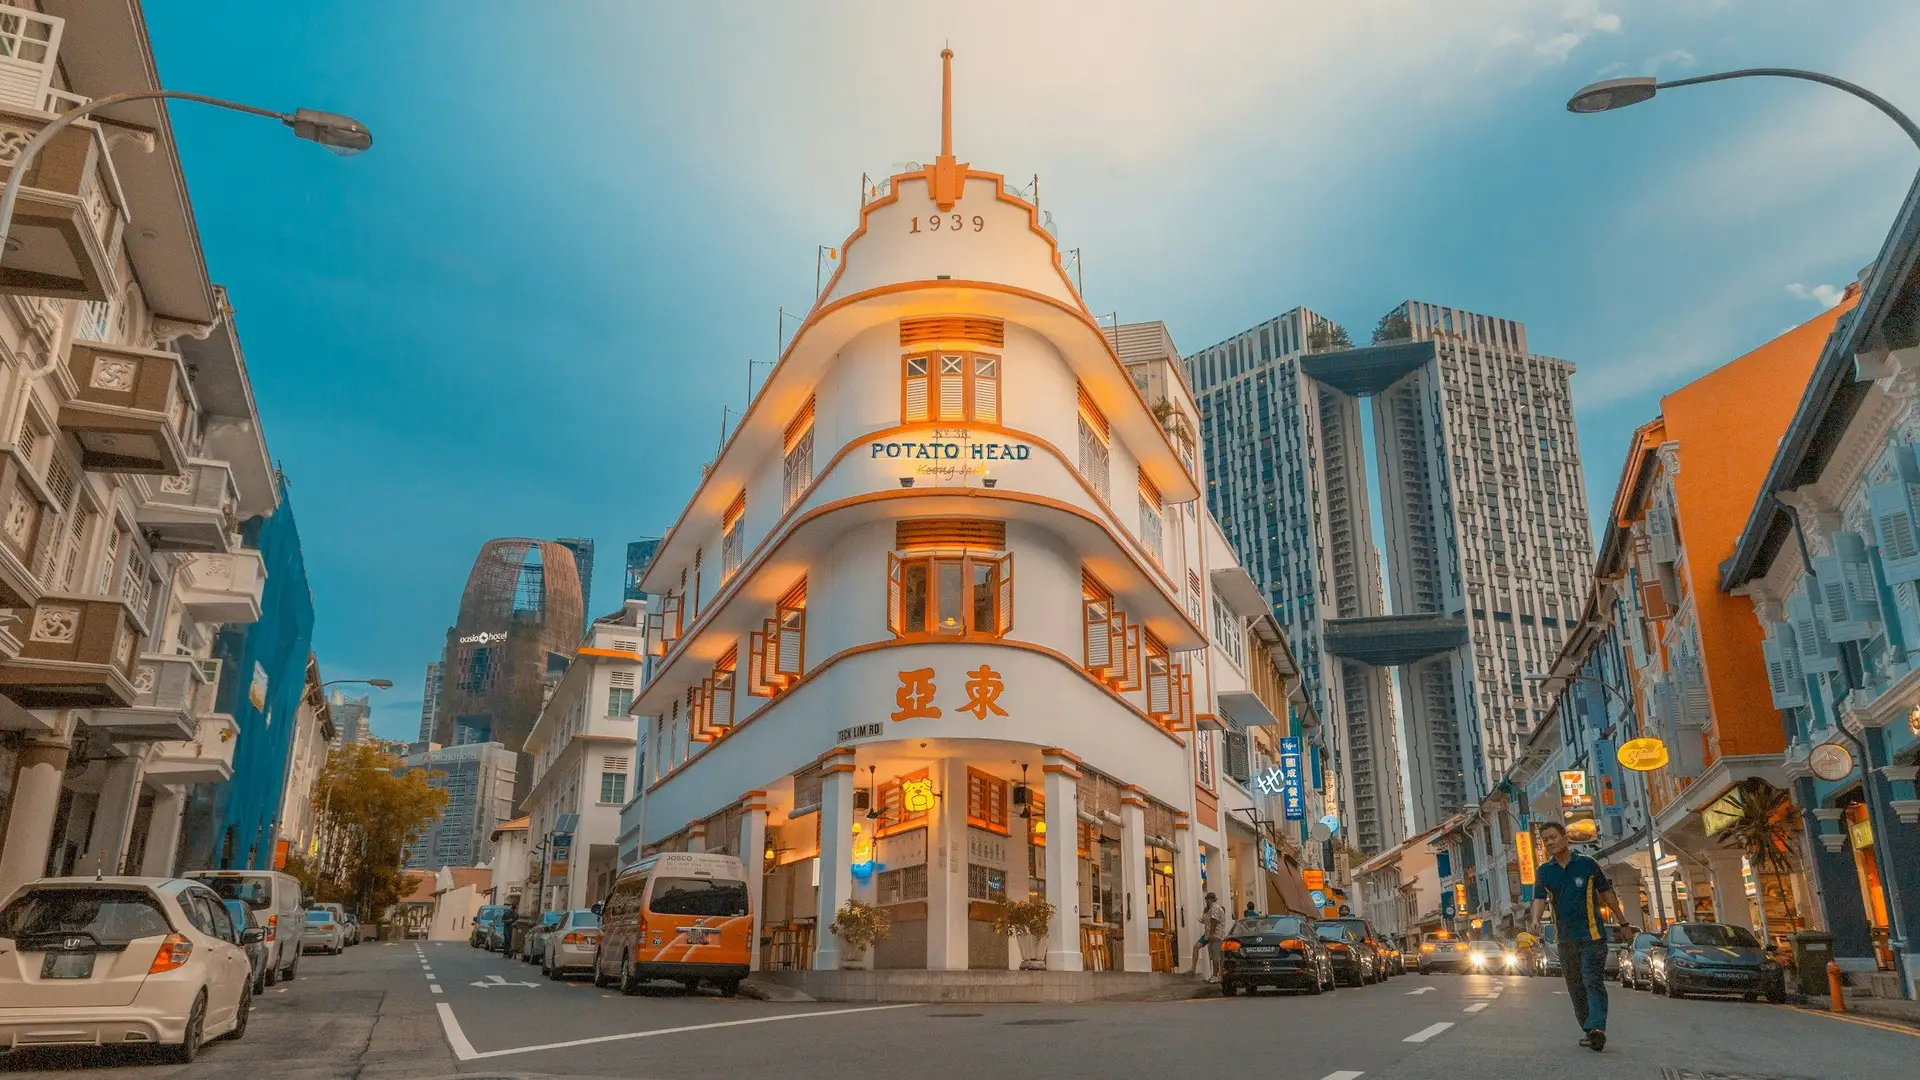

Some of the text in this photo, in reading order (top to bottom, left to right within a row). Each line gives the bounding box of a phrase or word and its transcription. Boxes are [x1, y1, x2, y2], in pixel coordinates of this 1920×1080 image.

[909, 213, 985, 234] 1939
[871, 443, 1031, 460] POTATO HEAD
[853, 725, 866, 738] LIM
[869, 723, 880, 735] RD
